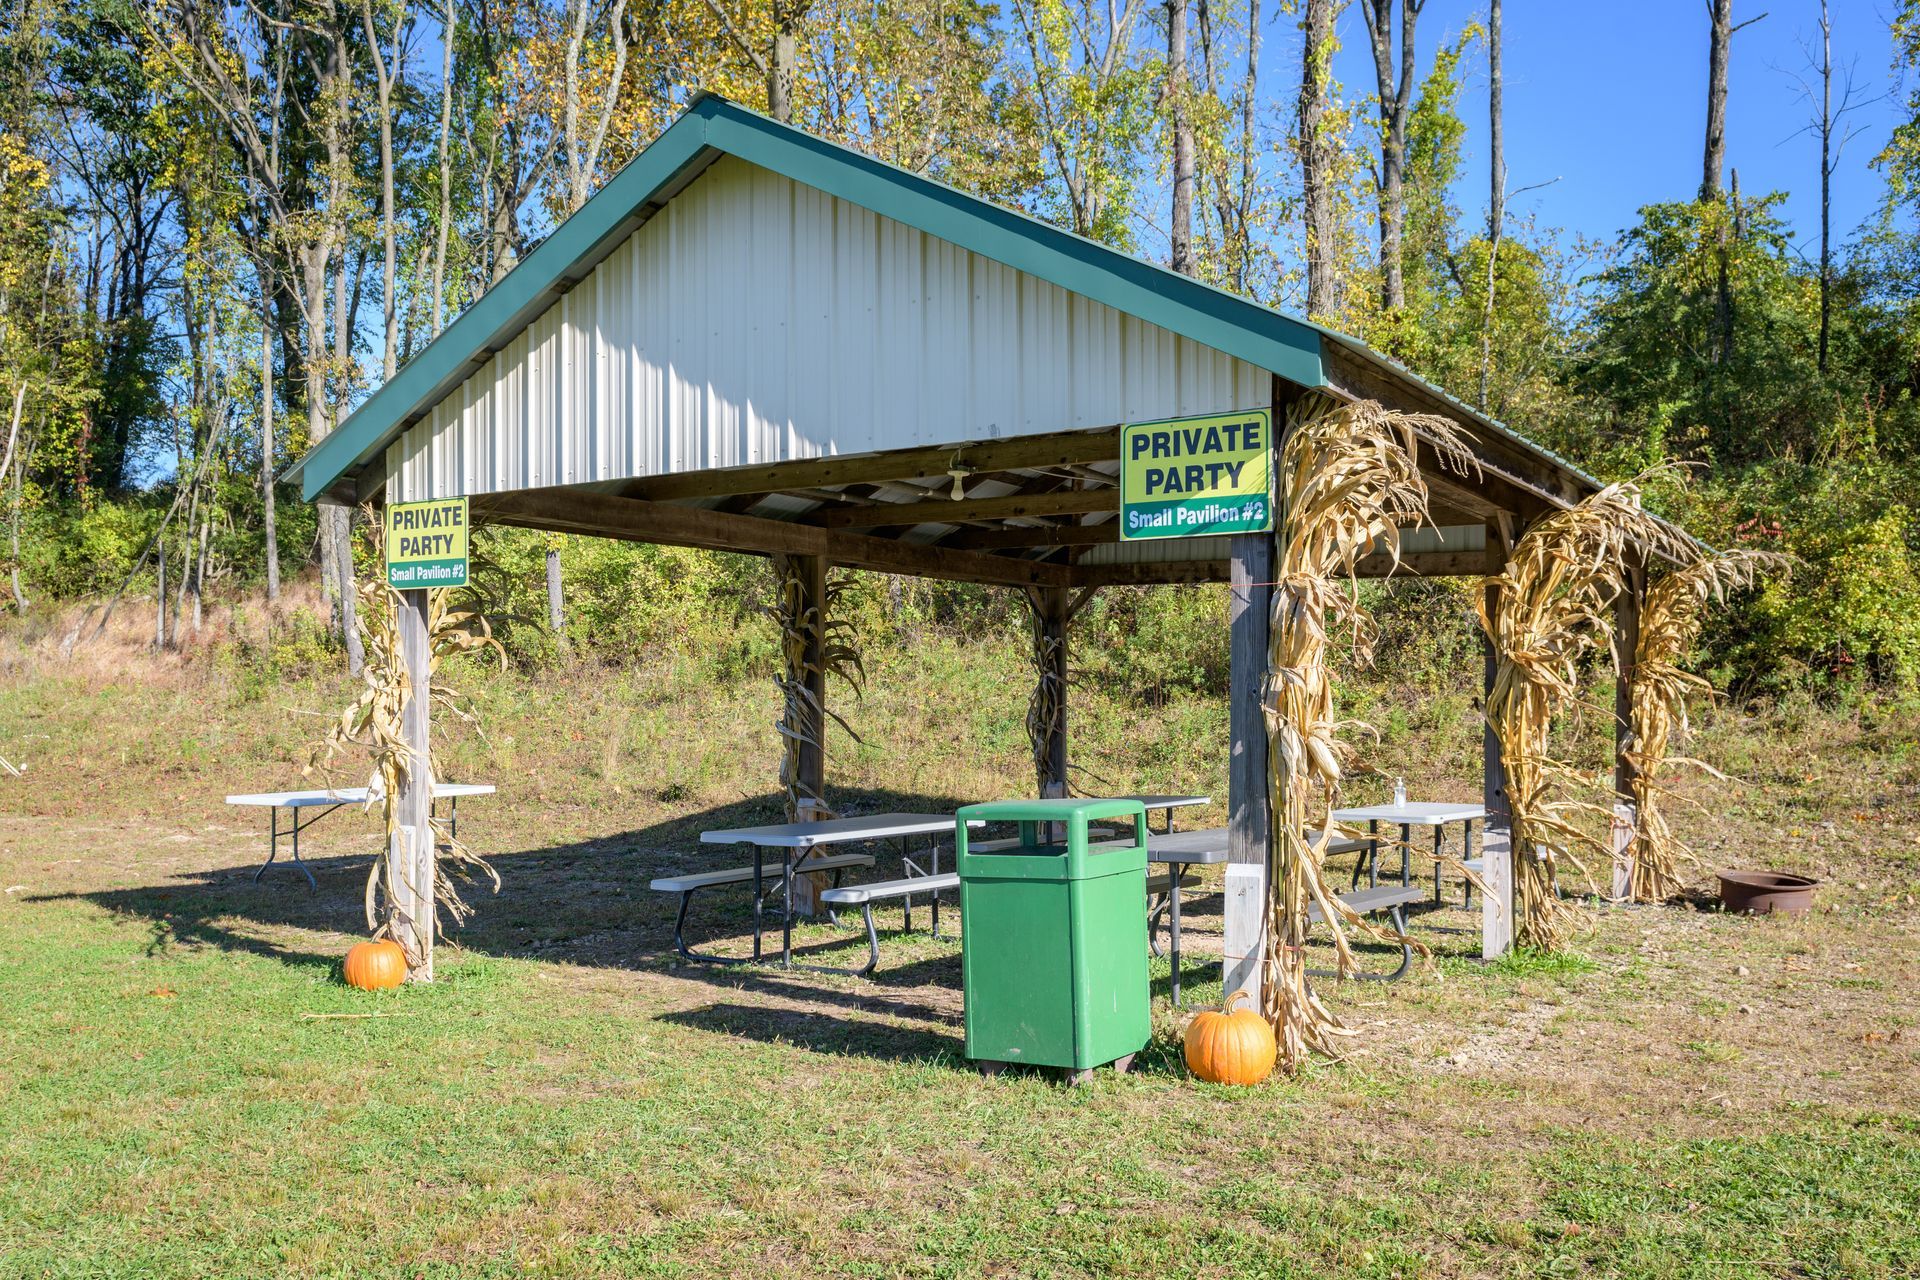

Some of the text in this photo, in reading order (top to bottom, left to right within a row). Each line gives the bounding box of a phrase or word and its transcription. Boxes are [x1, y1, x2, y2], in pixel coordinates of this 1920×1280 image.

[1132, 422, 1261, 460] PRIVATE
[1145, 461, 1245, 495] PARTY
[393, 506, 462, 531] PRIVATE
[1129, 502, 1264, 529] Small Pavilion #2
[400, 534, 454, 557] PARTY
[391, 564, 464, 582] Small Pavilion #2
